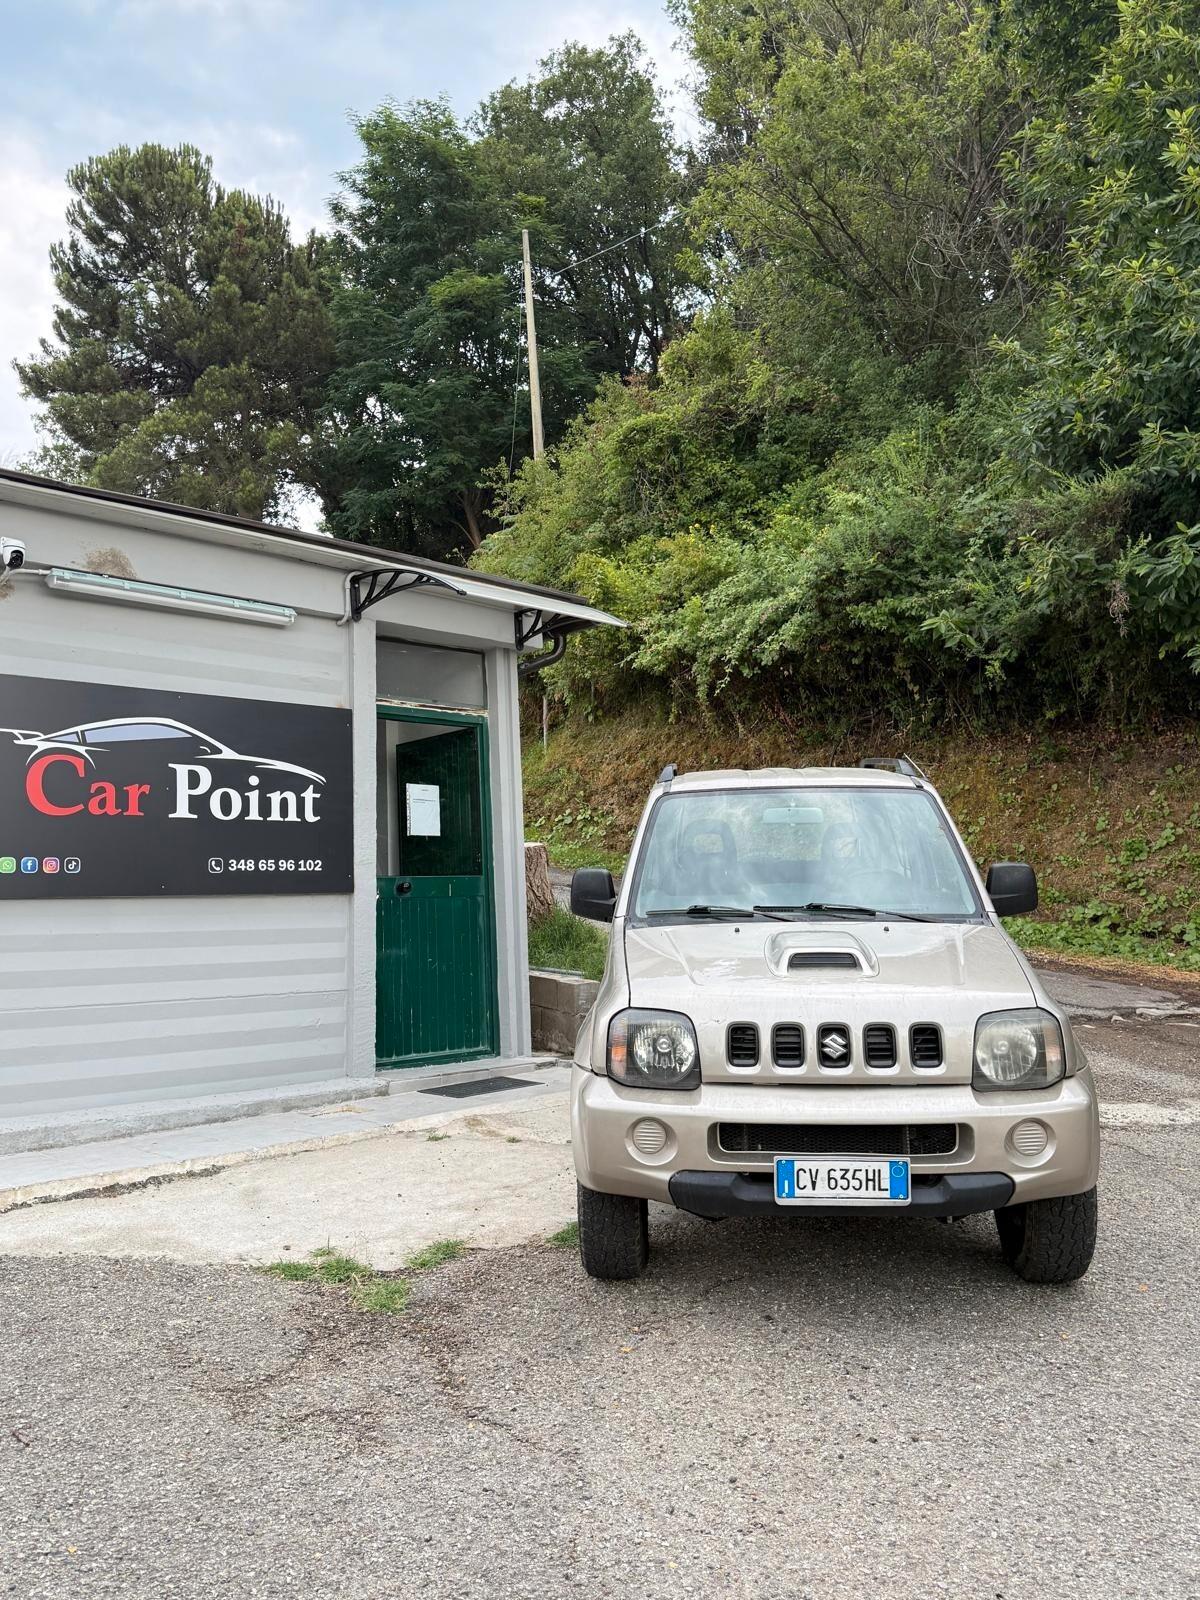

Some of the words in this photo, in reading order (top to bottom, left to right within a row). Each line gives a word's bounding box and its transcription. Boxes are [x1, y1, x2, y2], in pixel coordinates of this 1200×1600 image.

[26, 754, 150, 816] Car
[168, 763, 321, 823] Point
[228, 859, 255, 871] 348
[258, 859, 276, 871] 65
[278, 859, 295, 871] 96
[298, 859, 322, 871] 102
[796, 1168, 819, 1191] CV
[827, 1168, 889, 1192] 635HL
